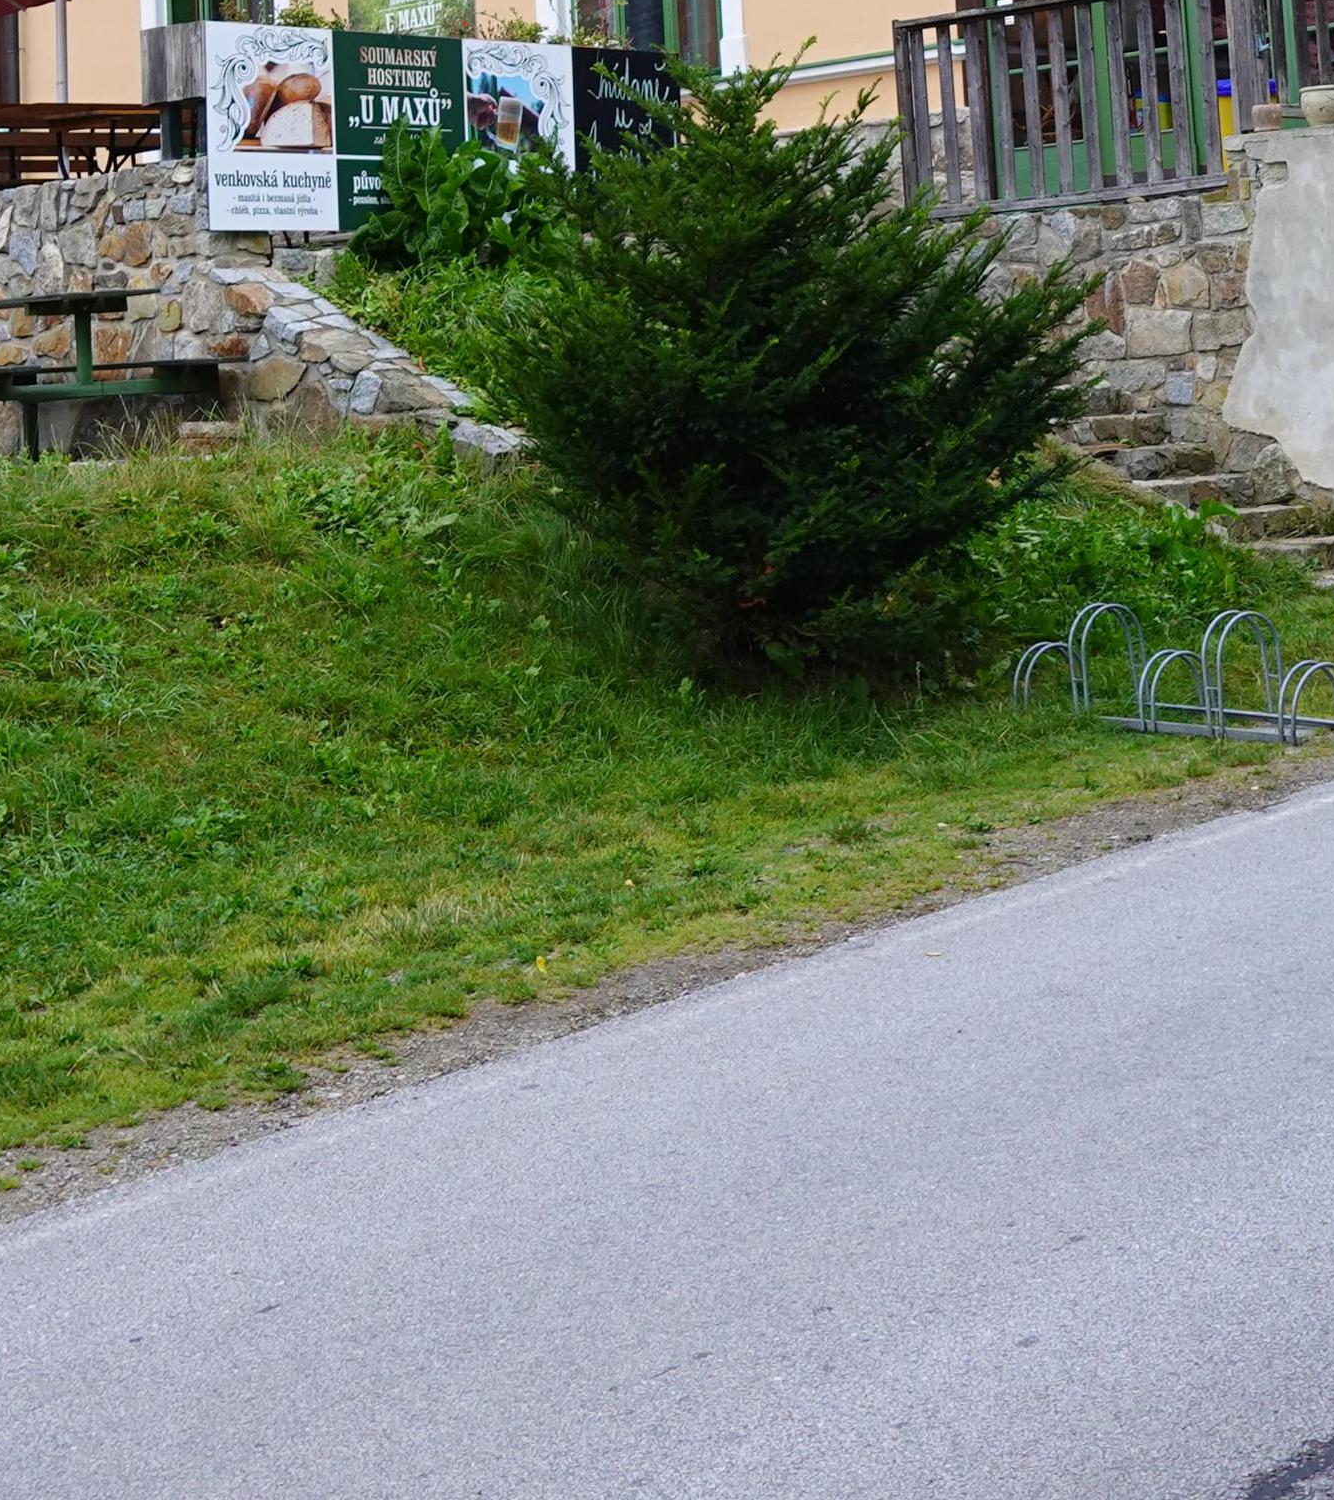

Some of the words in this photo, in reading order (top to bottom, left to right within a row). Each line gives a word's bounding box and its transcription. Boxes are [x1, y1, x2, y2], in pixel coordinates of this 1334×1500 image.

[359, 45, 437, 68] SOUMARSKÝ
[367, 68, 432, 88] HOSTINEC
[215, 169, 279, 188] venkovská
[282, 170, 332, 192] kuchyně
[353, 169, 382, 194] půvo
